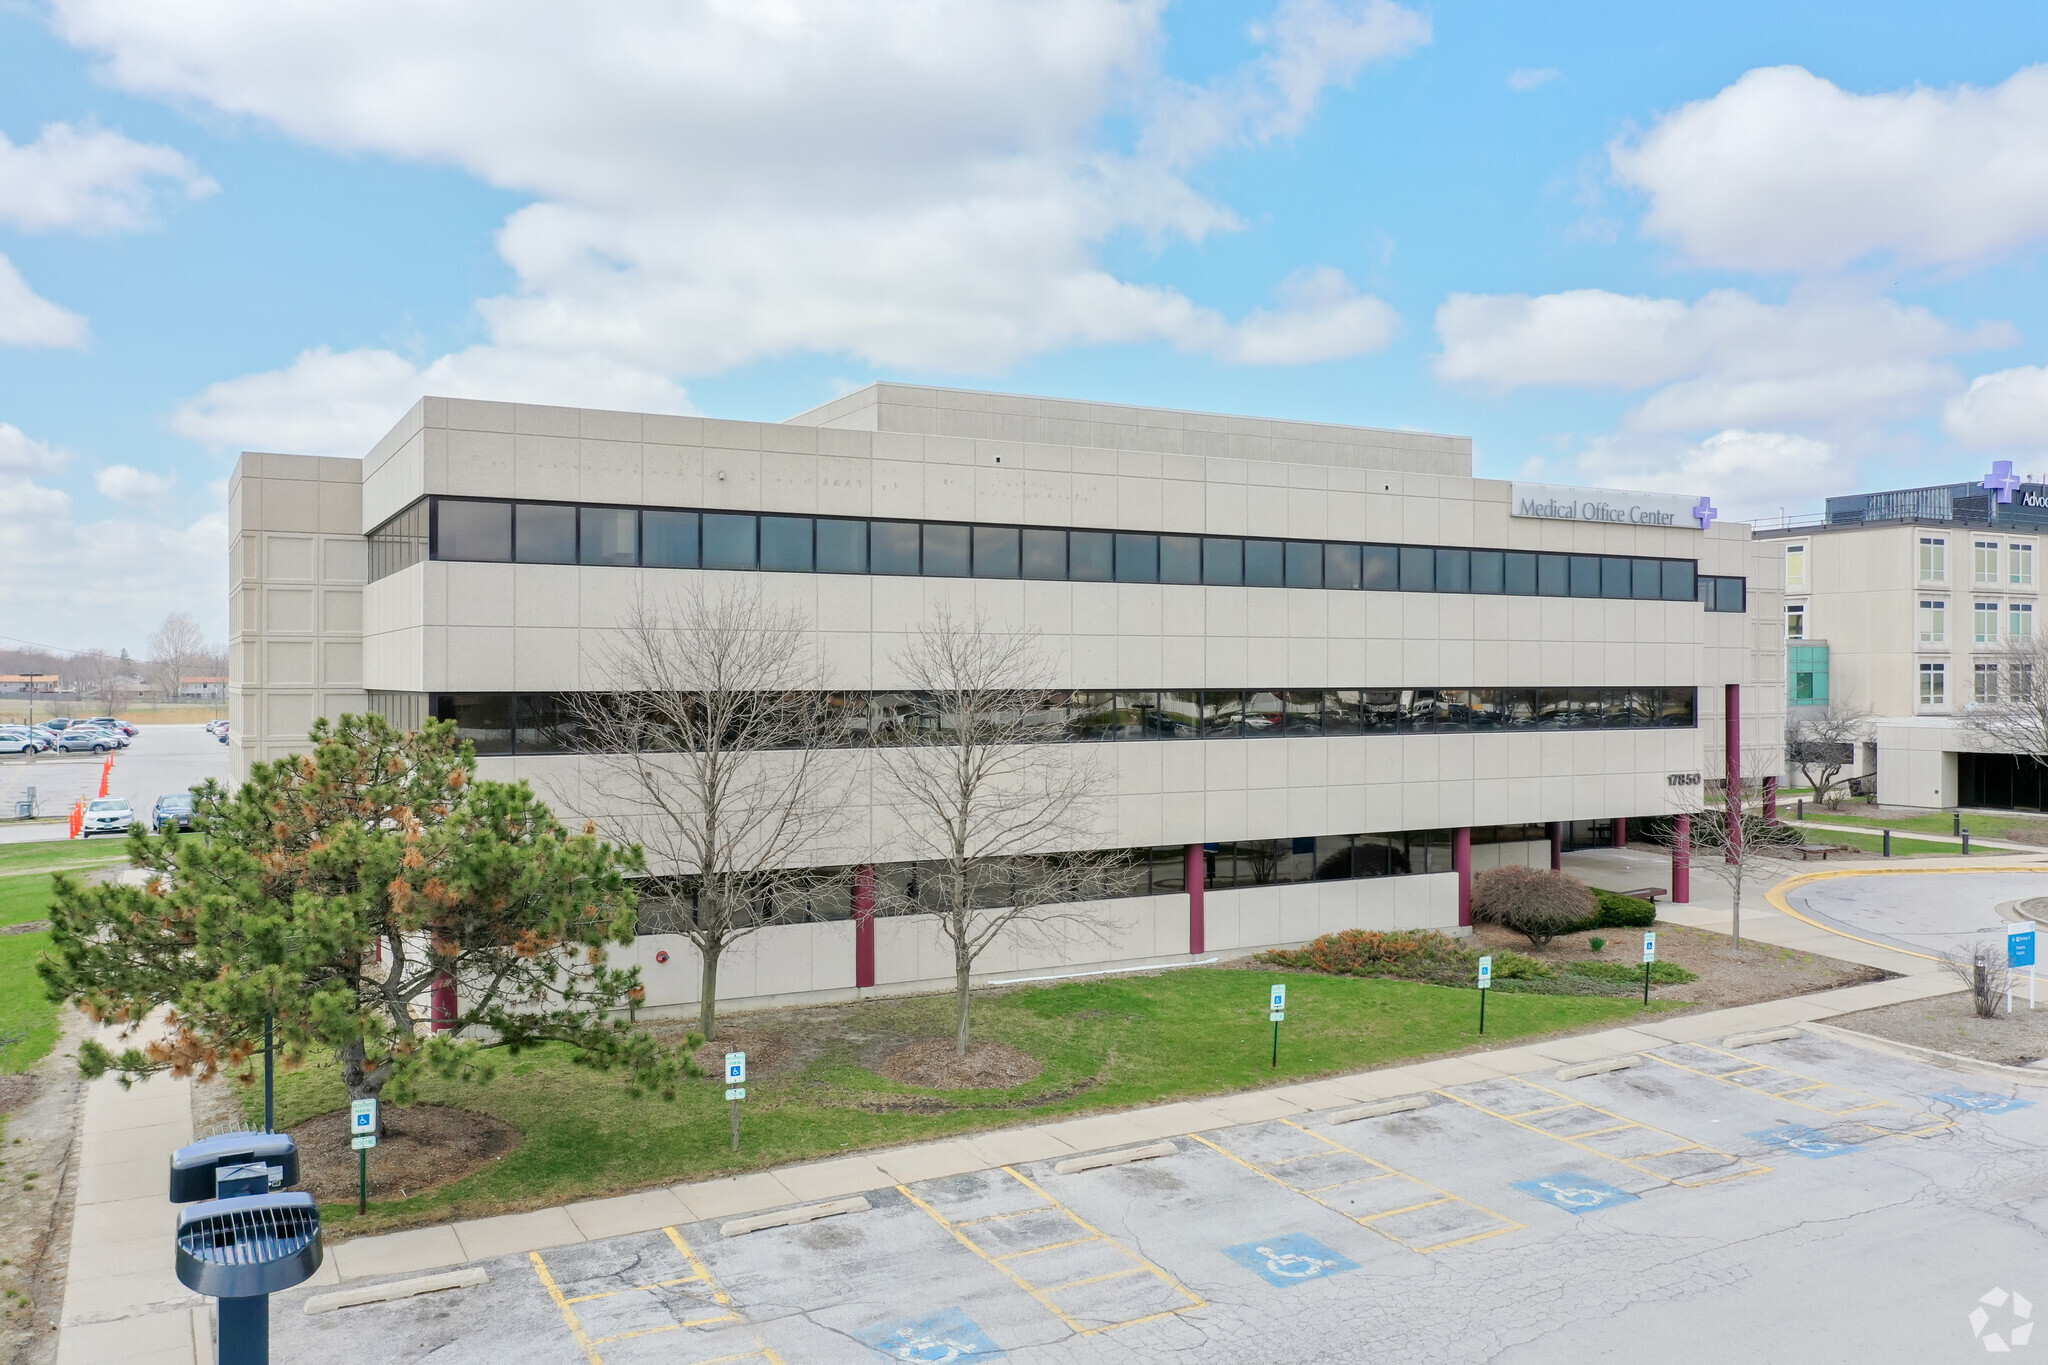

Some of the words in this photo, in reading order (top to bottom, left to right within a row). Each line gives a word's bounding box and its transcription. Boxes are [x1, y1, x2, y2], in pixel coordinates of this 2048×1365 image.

[1520, 498, 1577, 518] Medical
[1582, 502, 1625, 523] Office
[1629, 506, 1675, 526] Center
[1667, 773, 1702, 786] 17850
